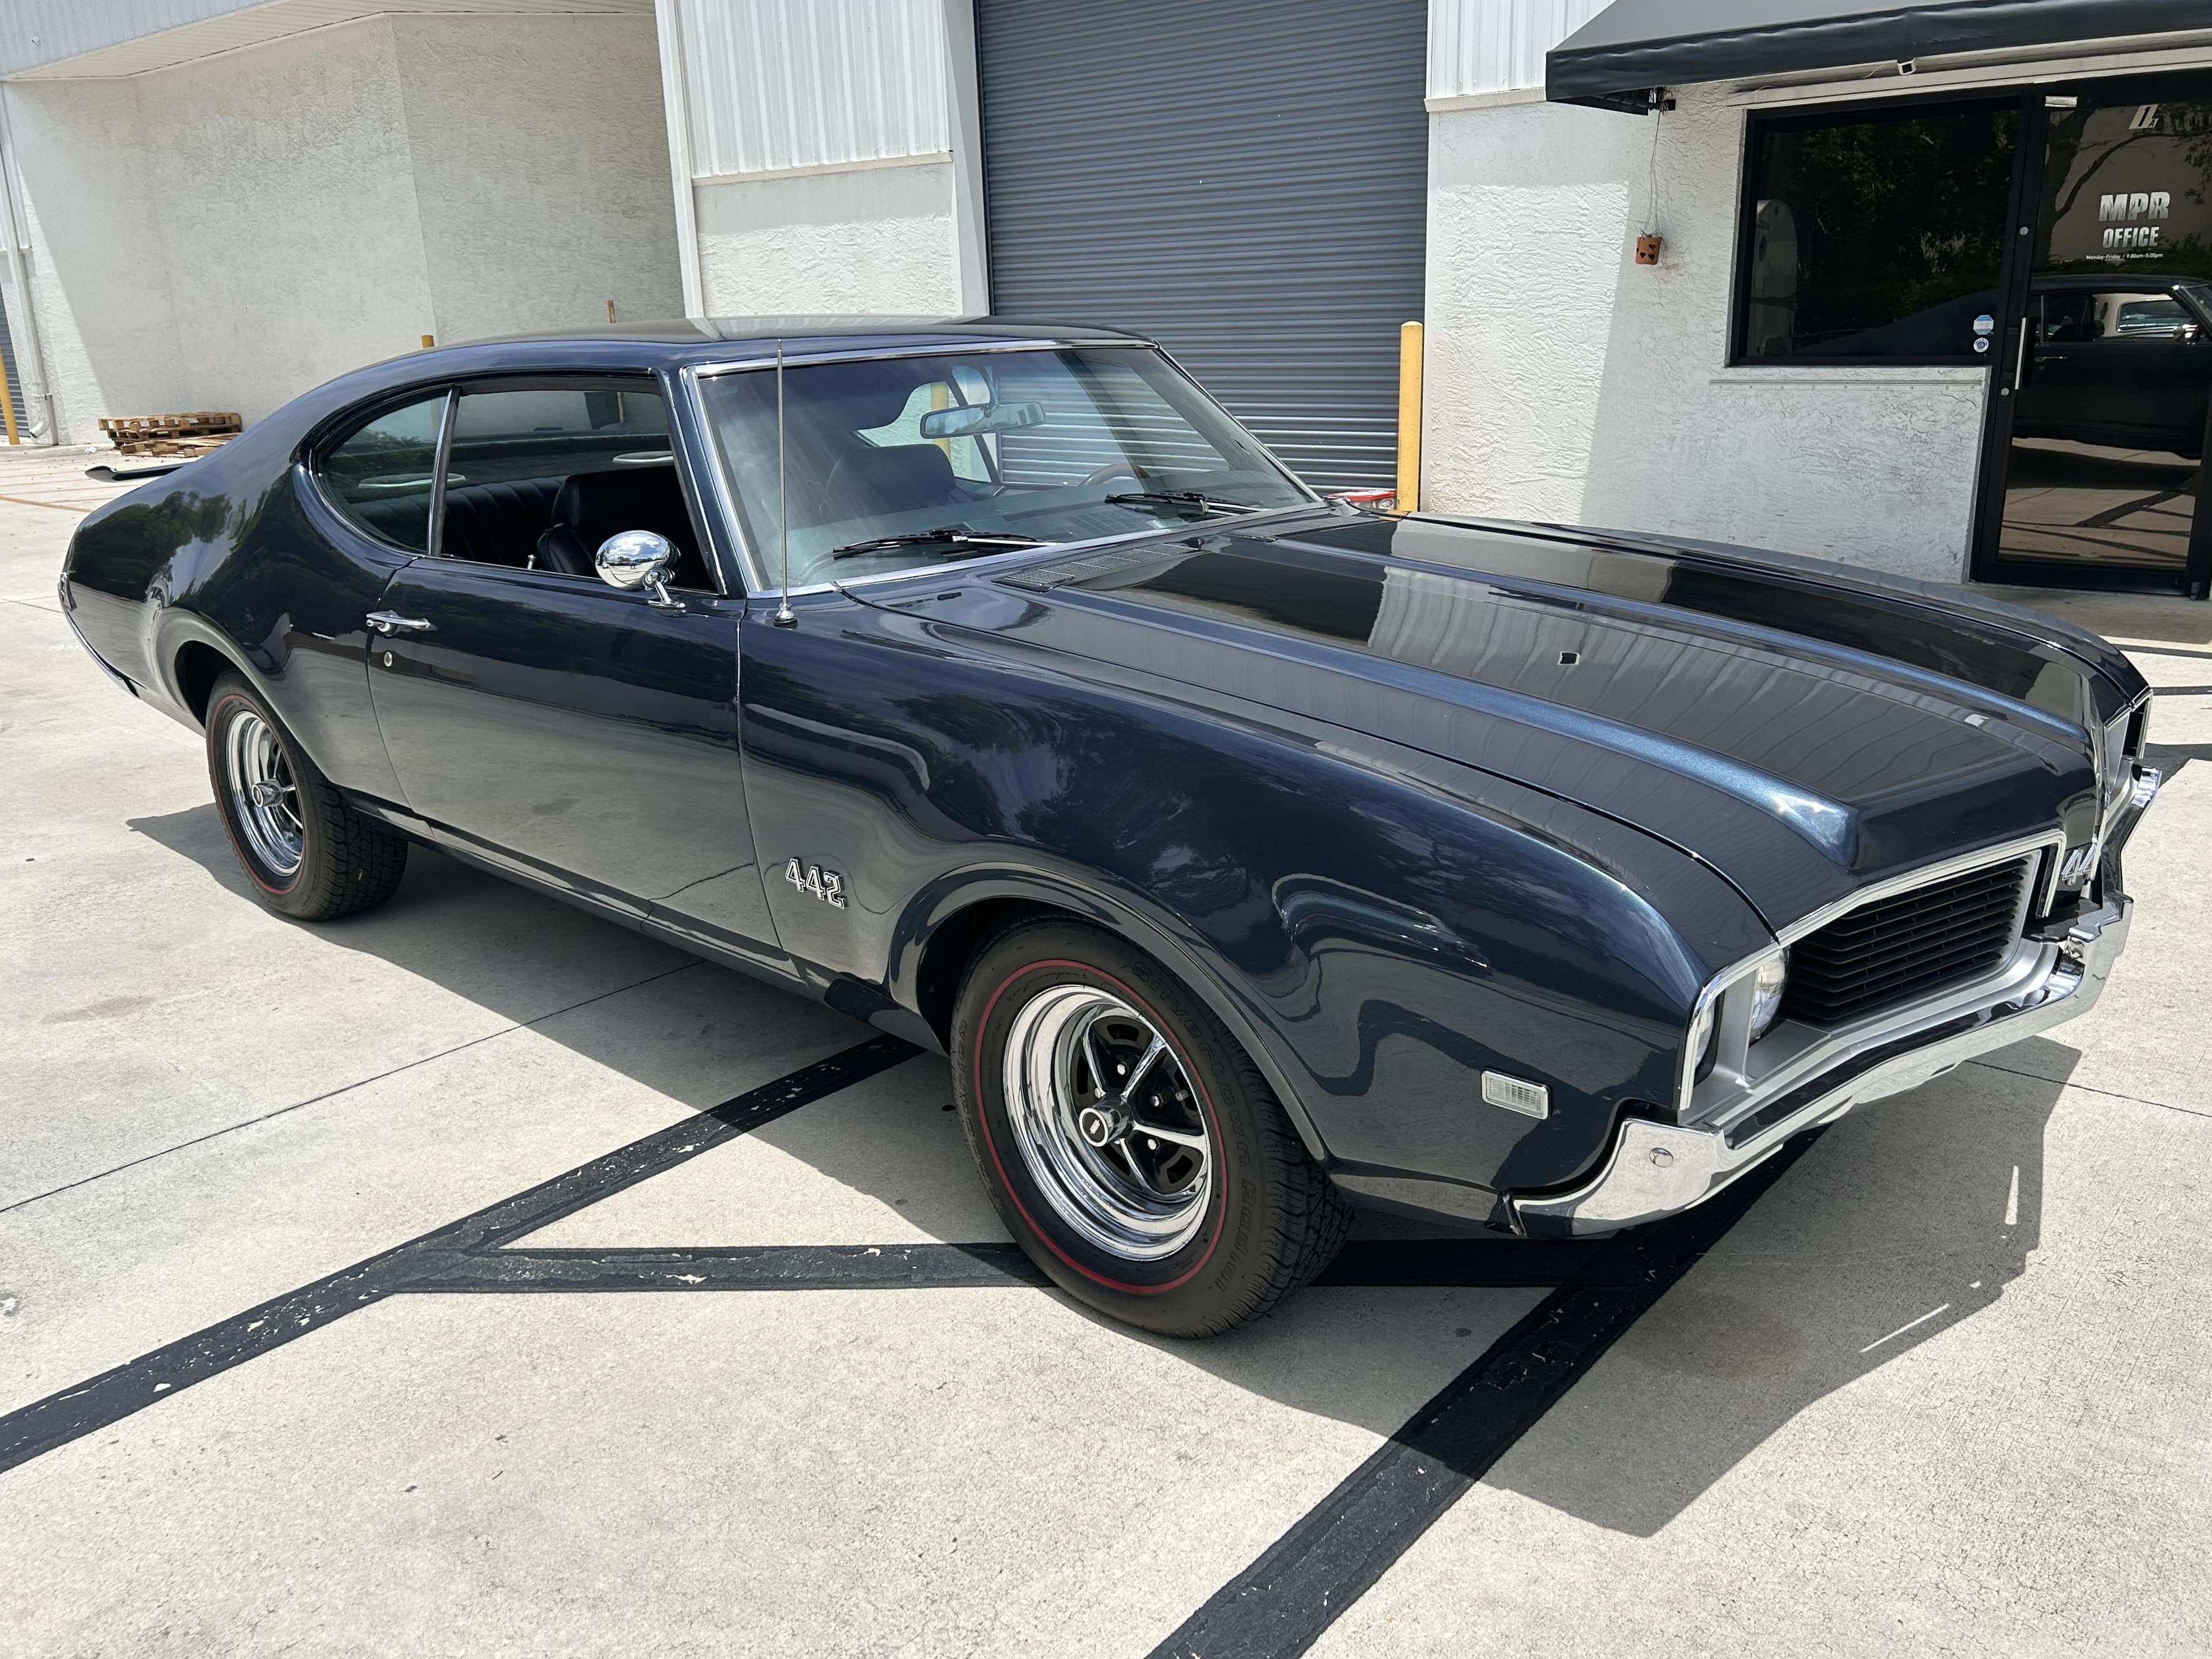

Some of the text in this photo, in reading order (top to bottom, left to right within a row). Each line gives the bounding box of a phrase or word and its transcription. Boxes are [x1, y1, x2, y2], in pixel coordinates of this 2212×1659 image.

[2099, 191, 2170, 222] MPR
[2103, 226, 2160, 248] OFFICE
[785, 857, 847, 910] 442
[1131, 961, 1256, 1292] Silvertown Radial
